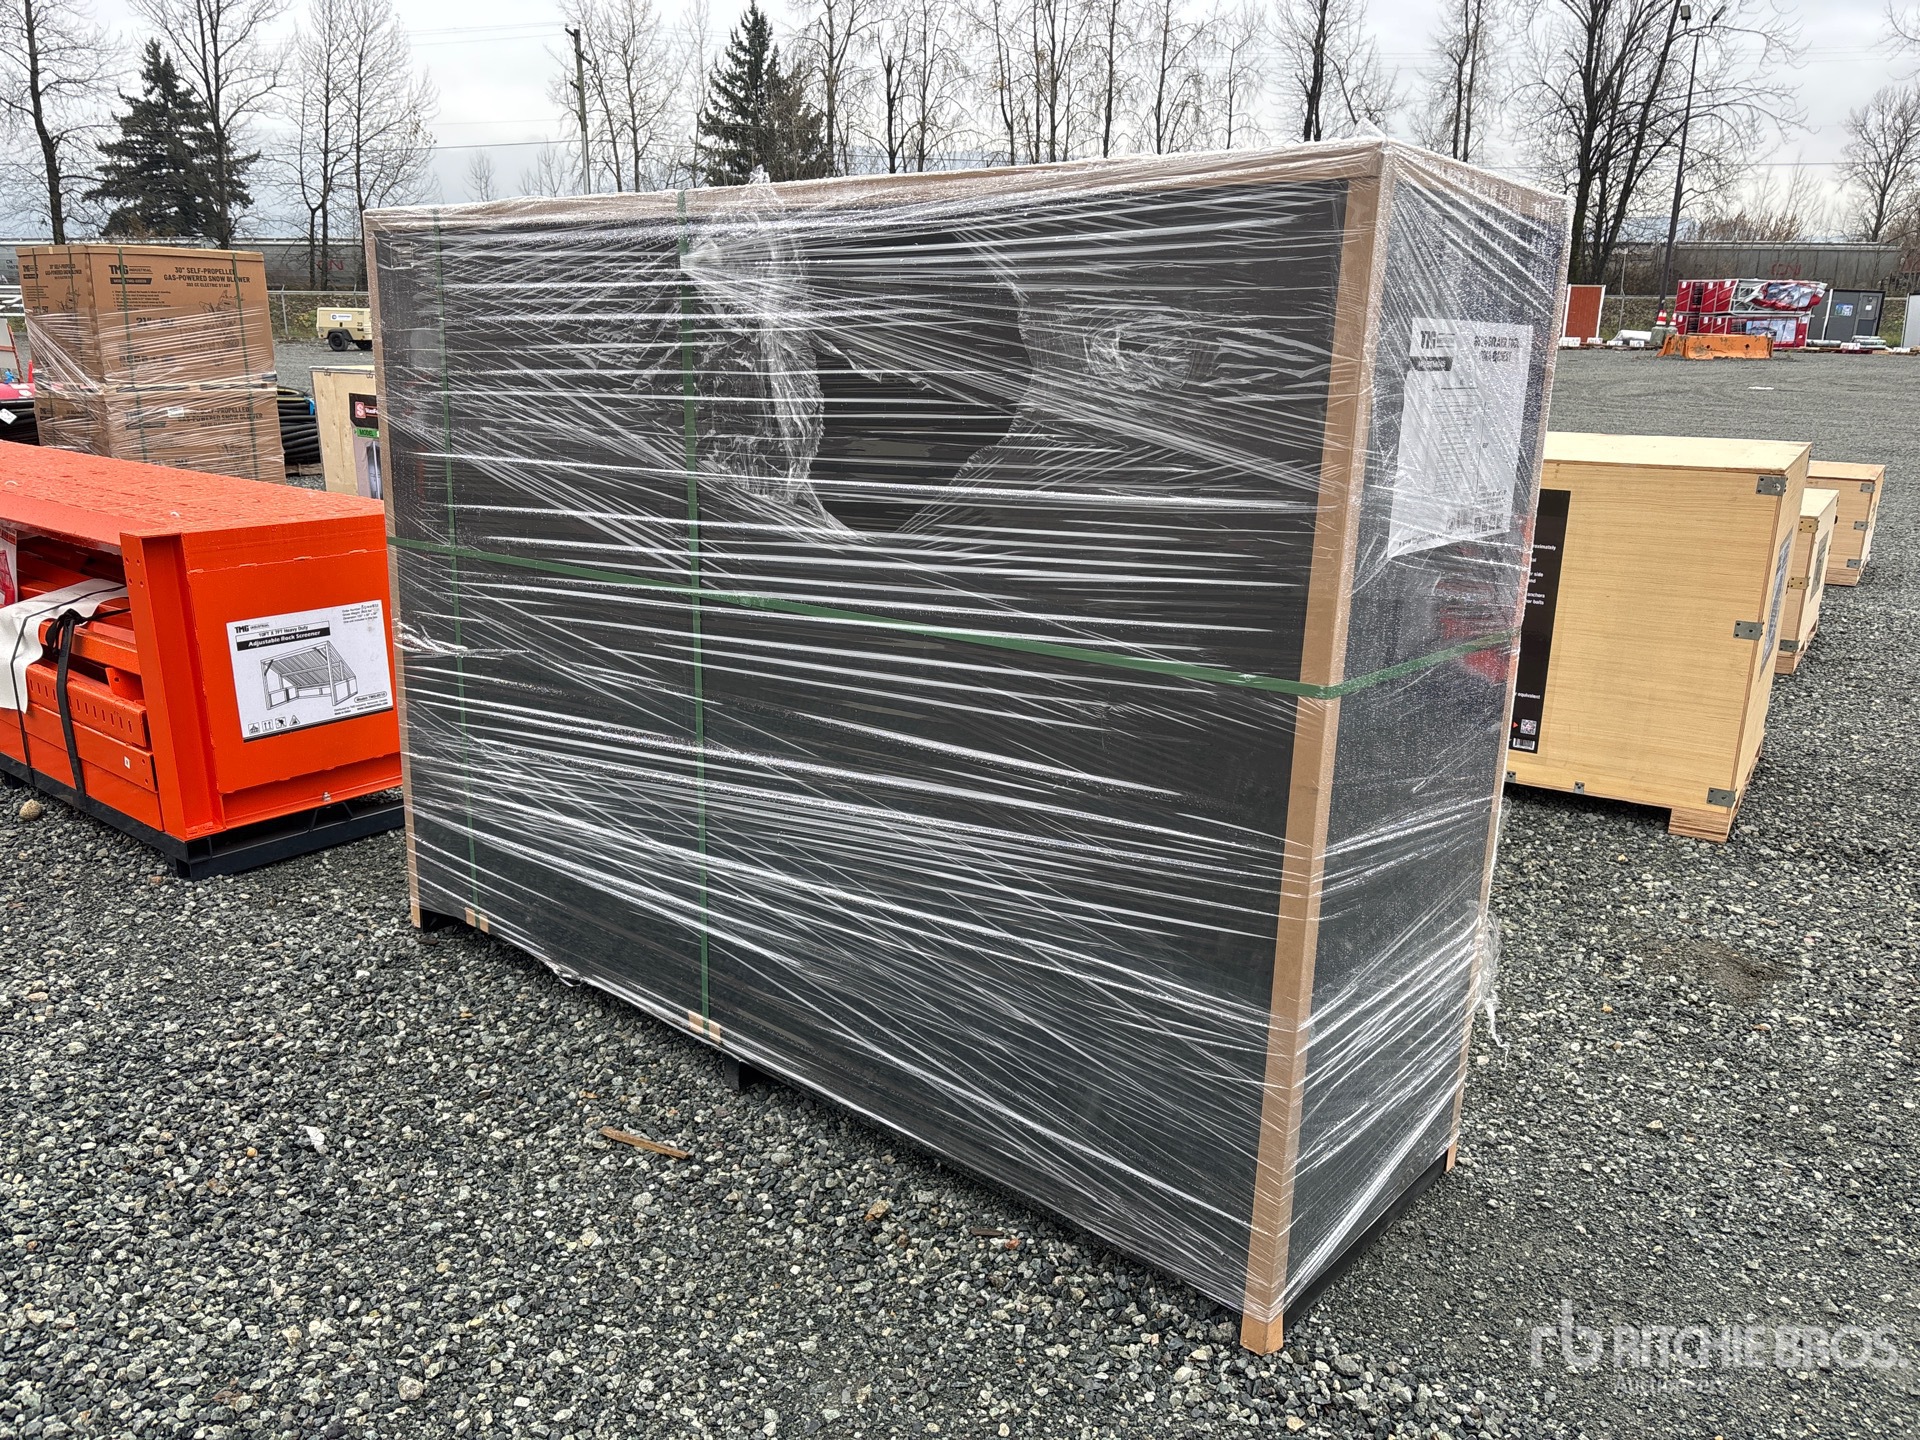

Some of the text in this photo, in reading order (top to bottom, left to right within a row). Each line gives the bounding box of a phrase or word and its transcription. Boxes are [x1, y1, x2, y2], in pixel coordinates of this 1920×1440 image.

[187, 267, 237, 275] SELF-PROPELLE
[235, 625, 250, 634] TMG
[248, 631, 321, 647] Adjustable Rock Screener
